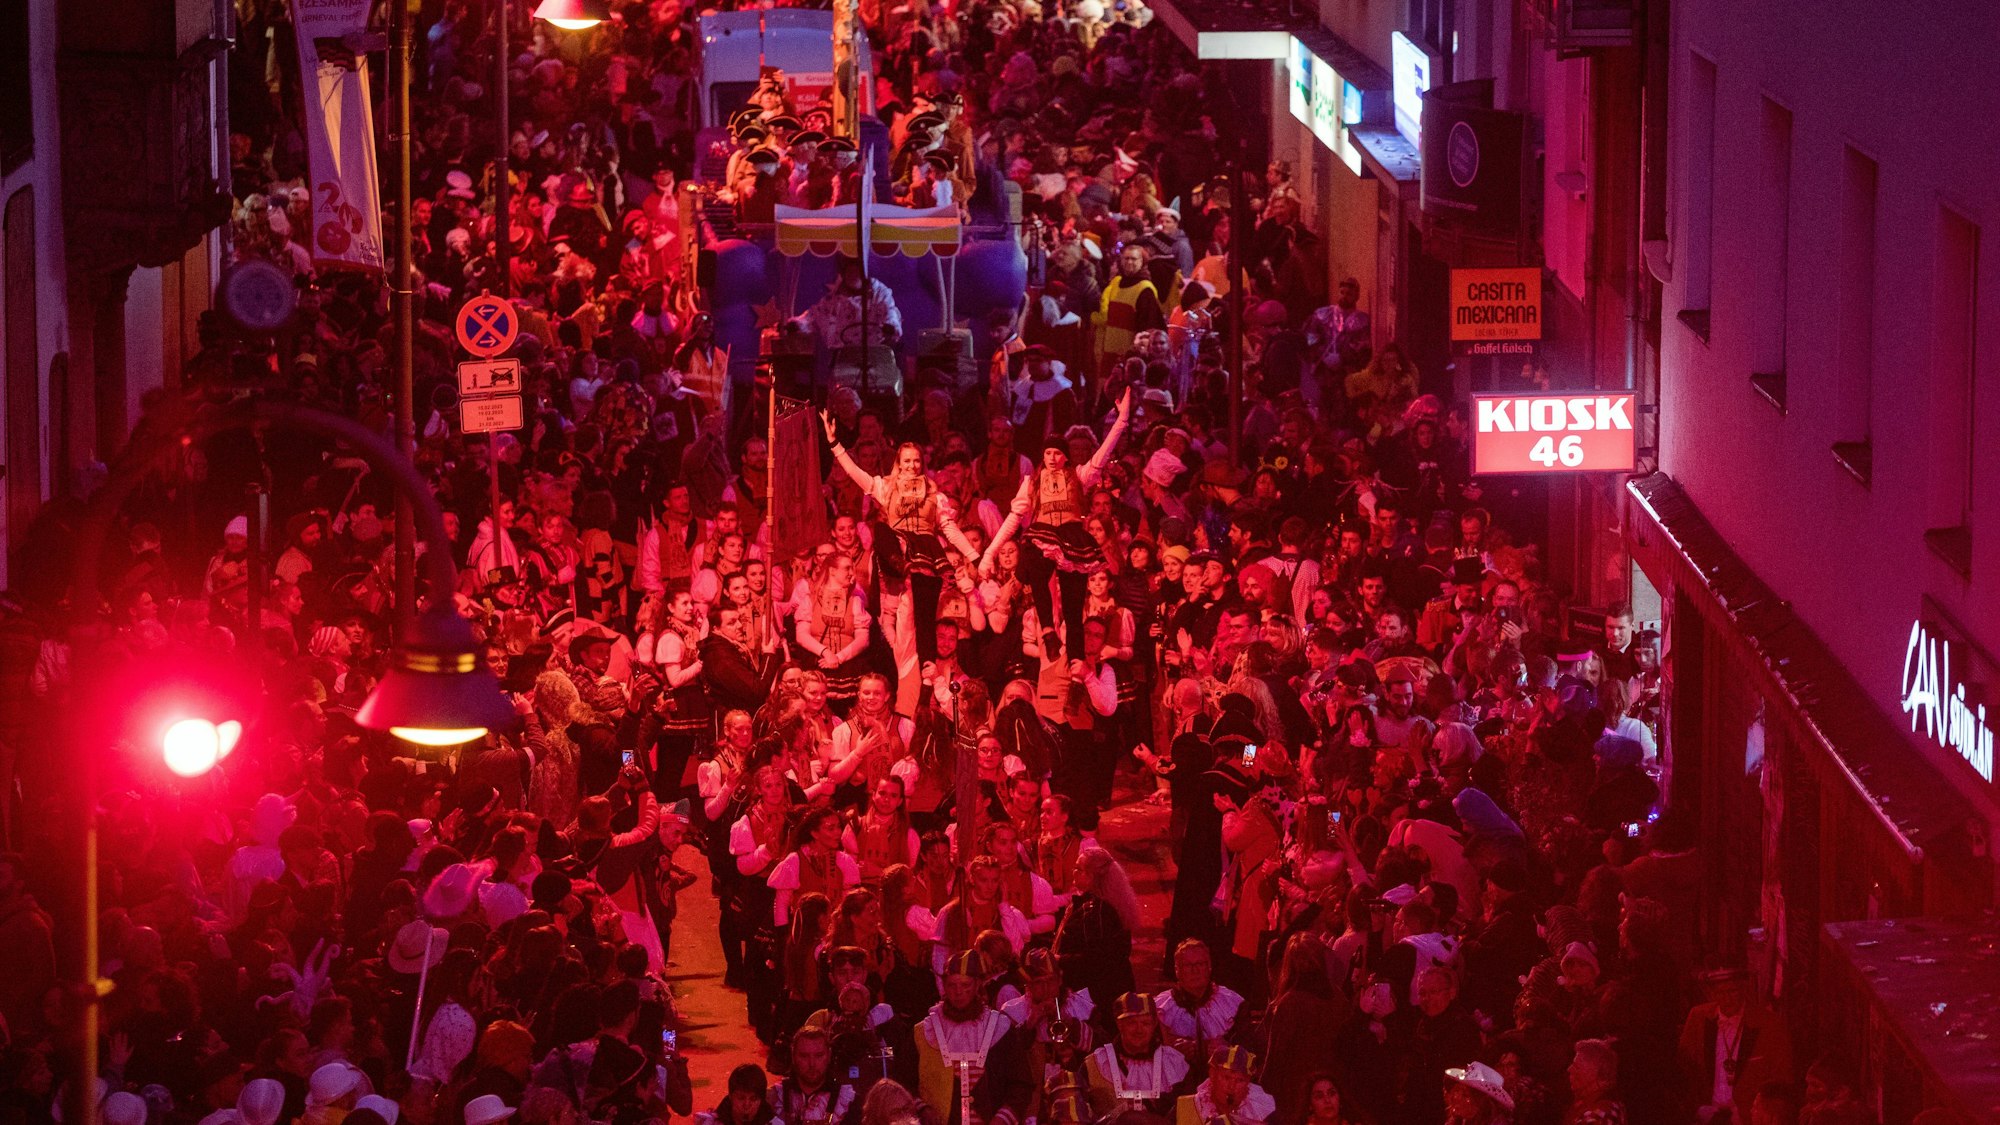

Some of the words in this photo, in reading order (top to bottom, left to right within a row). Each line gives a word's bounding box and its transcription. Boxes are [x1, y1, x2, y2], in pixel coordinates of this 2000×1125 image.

[1467, 282, 1526, 301] CASITA
[1456, 305, 1537, 324] MEXICANA
[1474, 342, 1500, 354] Gaffel
[1502, 342, 1533, 354] Kölsch
[1478, 397, 1632, 432] KIOSK
[1529, 435, 1584, 467] 46
